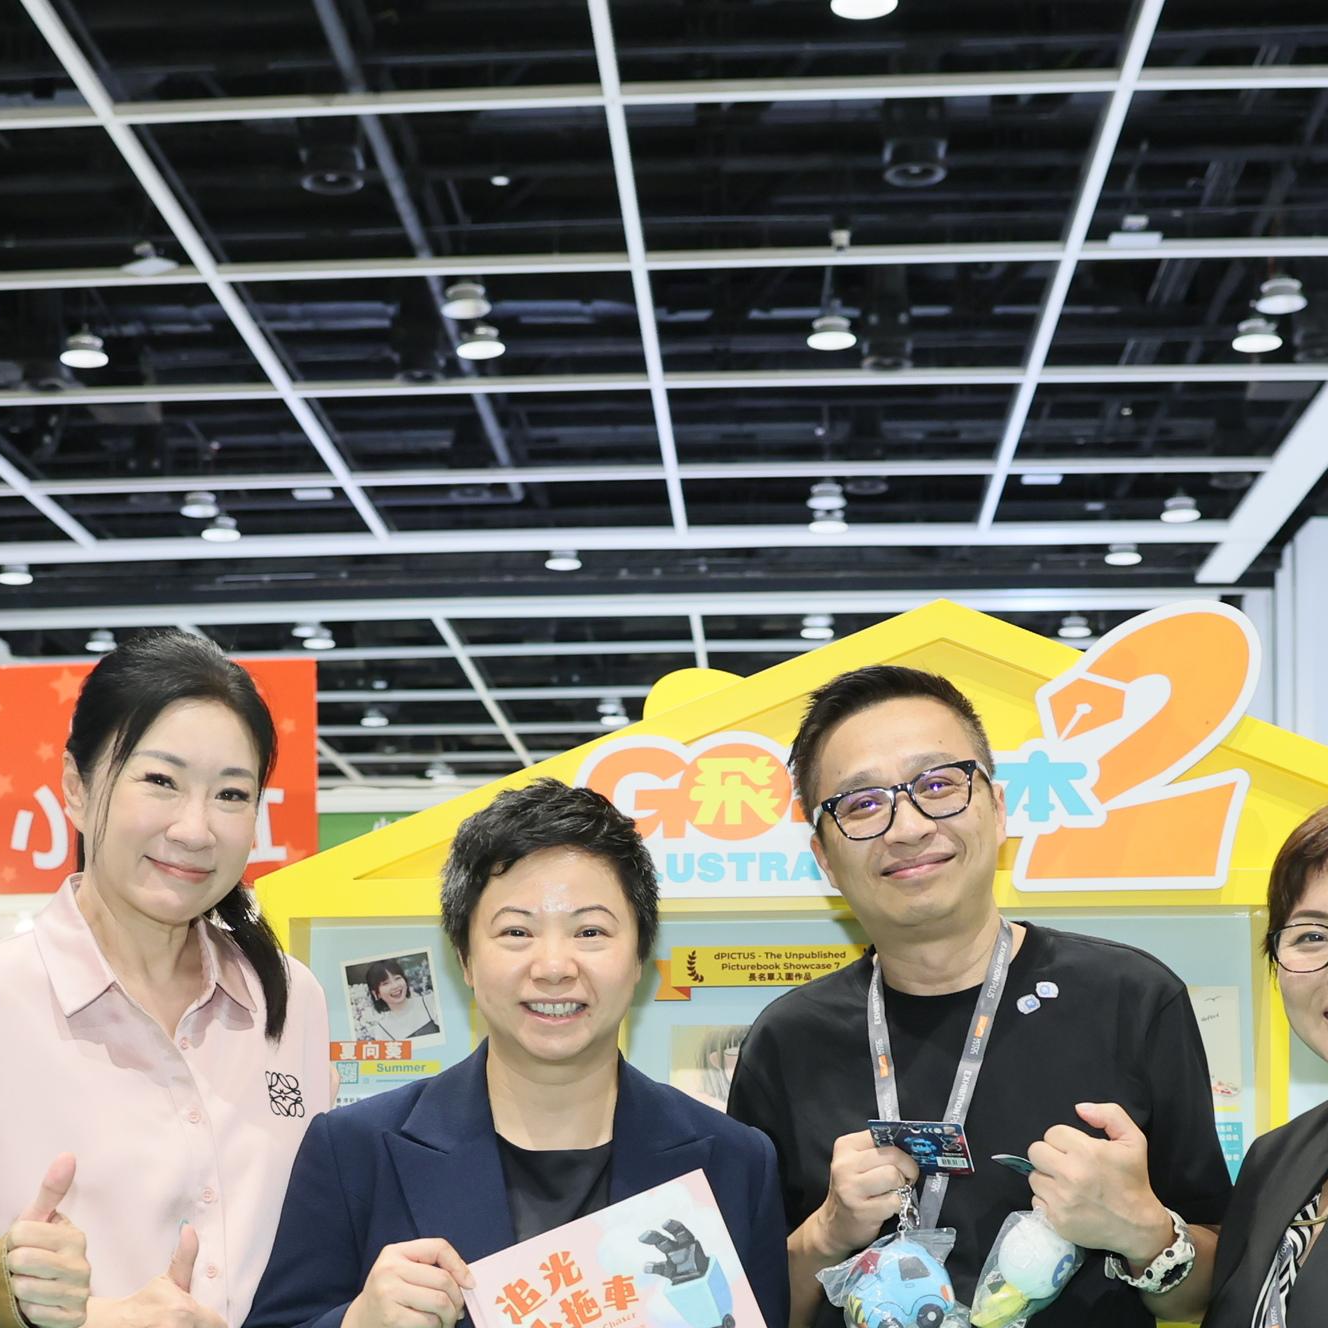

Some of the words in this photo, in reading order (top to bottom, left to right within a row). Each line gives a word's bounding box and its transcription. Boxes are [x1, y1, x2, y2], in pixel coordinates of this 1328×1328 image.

[714, 951, 756, 960] dPICTUS
[764, 951, 782, 960] The
[784, 951, 846, 961] Unpublished
[722, 962, 781, 970] Picturebook
[783, 961, 832, 970] Showcase
[834, 962, 840, 970] 7
[991, 941, 1008, 982] EXHIBITION
[376, 1062, 426, 1073] Summer
[953, 1070, 972, 1116] EXHIBITION
[495, 1251, 583, 1325] 追光
